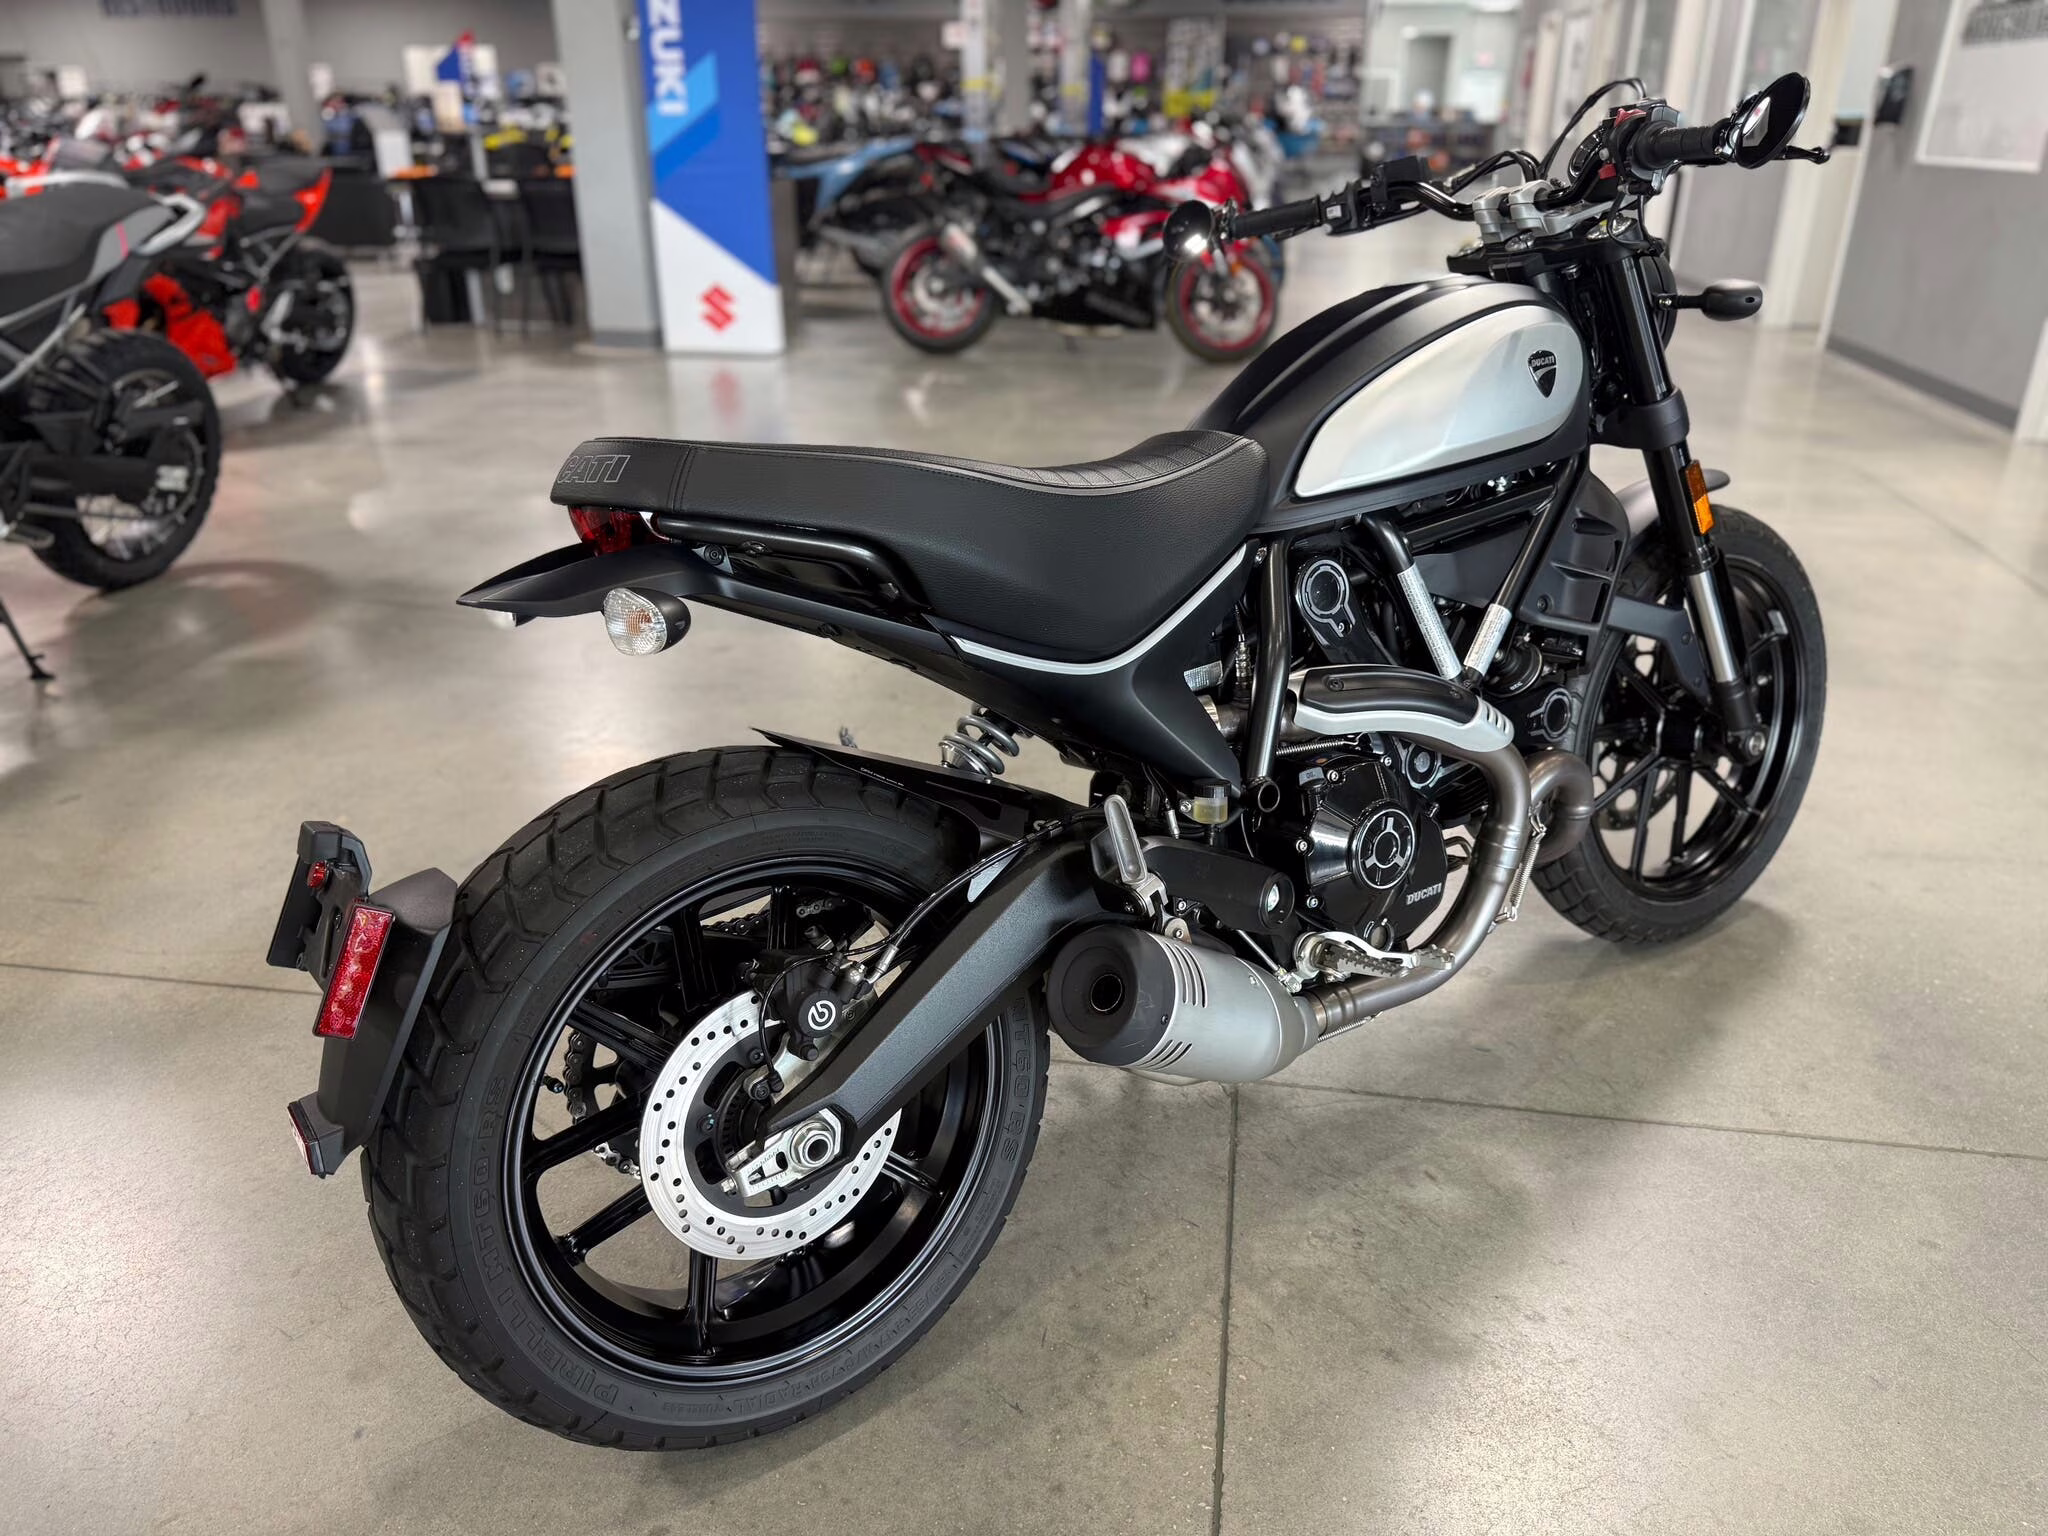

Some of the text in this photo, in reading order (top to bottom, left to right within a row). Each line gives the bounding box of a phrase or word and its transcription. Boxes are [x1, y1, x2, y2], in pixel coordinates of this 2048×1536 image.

[1531, 355, 1555, 367] DUCATI
[1406, 882, 1442, 905] DUCATI
[499, 1287, 620, 1405] PIRELLI
[733, 1382, 803, 1416] RADIAL
